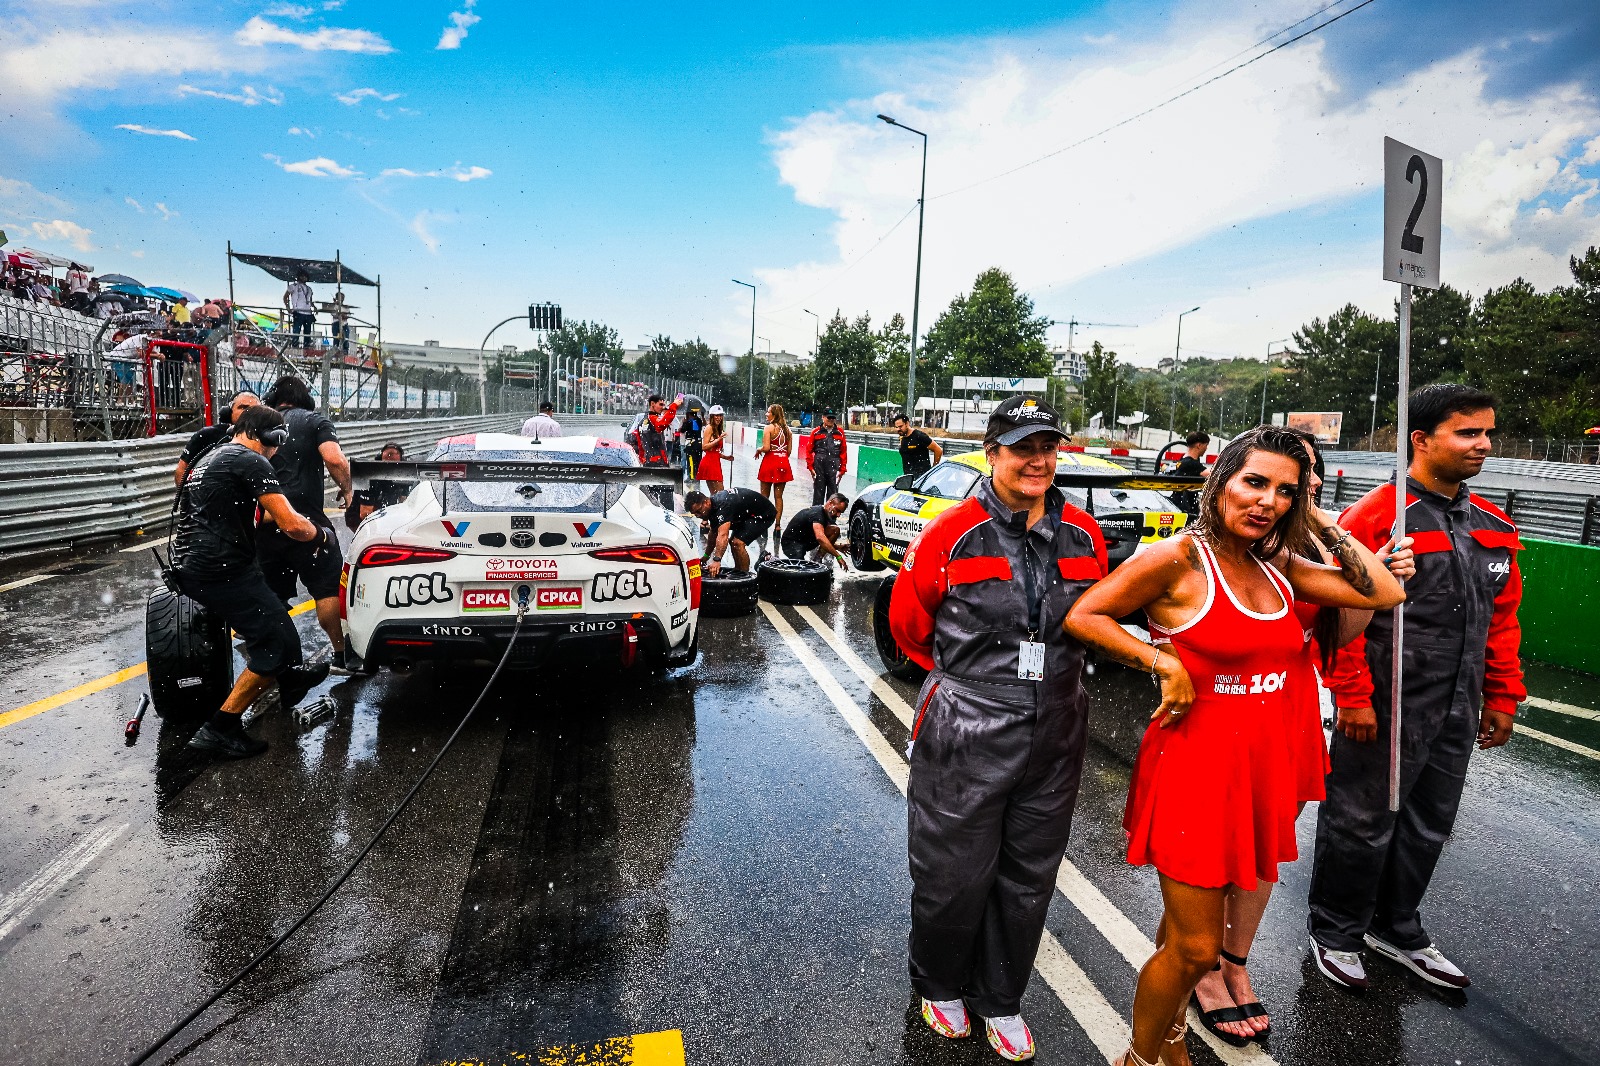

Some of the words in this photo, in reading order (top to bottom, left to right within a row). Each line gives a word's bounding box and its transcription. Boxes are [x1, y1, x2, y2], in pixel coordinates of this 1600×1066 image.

[1401, 154, 1428, 254] 2
[977, 381, 1007, 391] Vialsil
[419, 471, 465, 479] GR
[477, 464, 535, 472] TOYOTA
[592, 467, 638, 477] acing
[440, 540, 474, 549] Valvoline
[571, 541, 603, 549] Valvoline
[507, 559, 558, 568] TOYOTA
[386, 572, 453, 608] NGL
[591, 569, 652, 602] NGL
[465, 592, 508, 605] CPKA
[539, 591, 580, 603] CPKA
